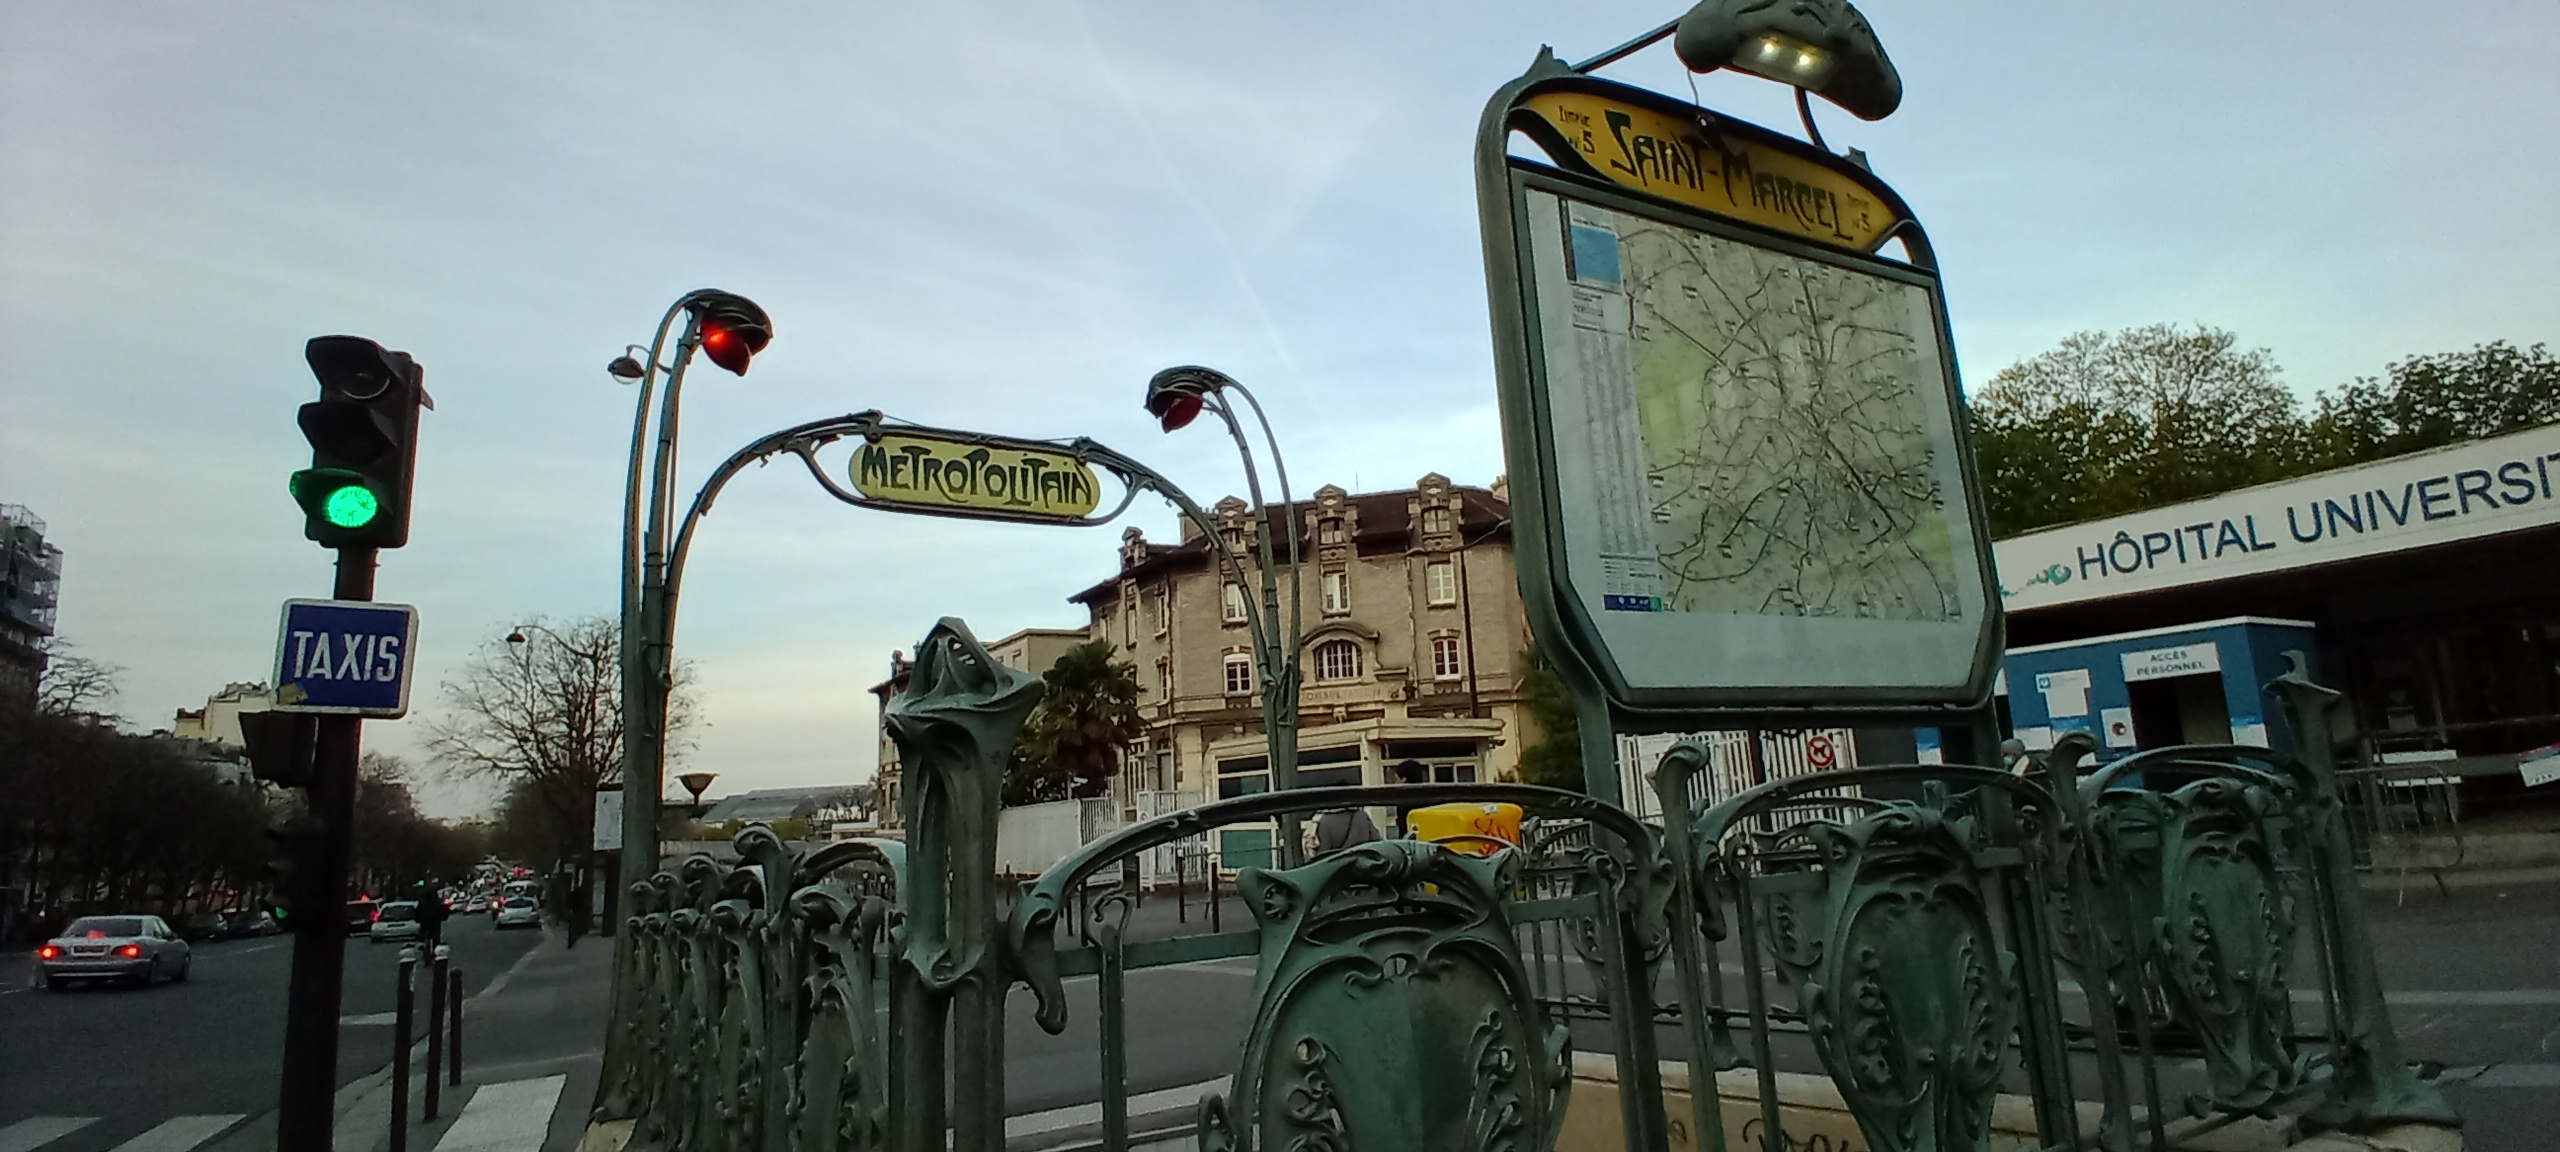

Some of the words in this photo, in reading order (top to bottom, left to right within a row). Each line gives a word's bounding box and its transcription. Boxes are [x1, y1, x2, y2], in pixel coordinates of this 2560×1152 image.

[1603, 108, 1854, 242] SAINT-MARCEL
[860, 444, 1092, 509] METROPOLITAIN
[2076, 514, 2277, 581] HÔPITAL
[293, 630, 400, 683] TAXIS
[2136, 661, 2206, 676] PERSONNEL
